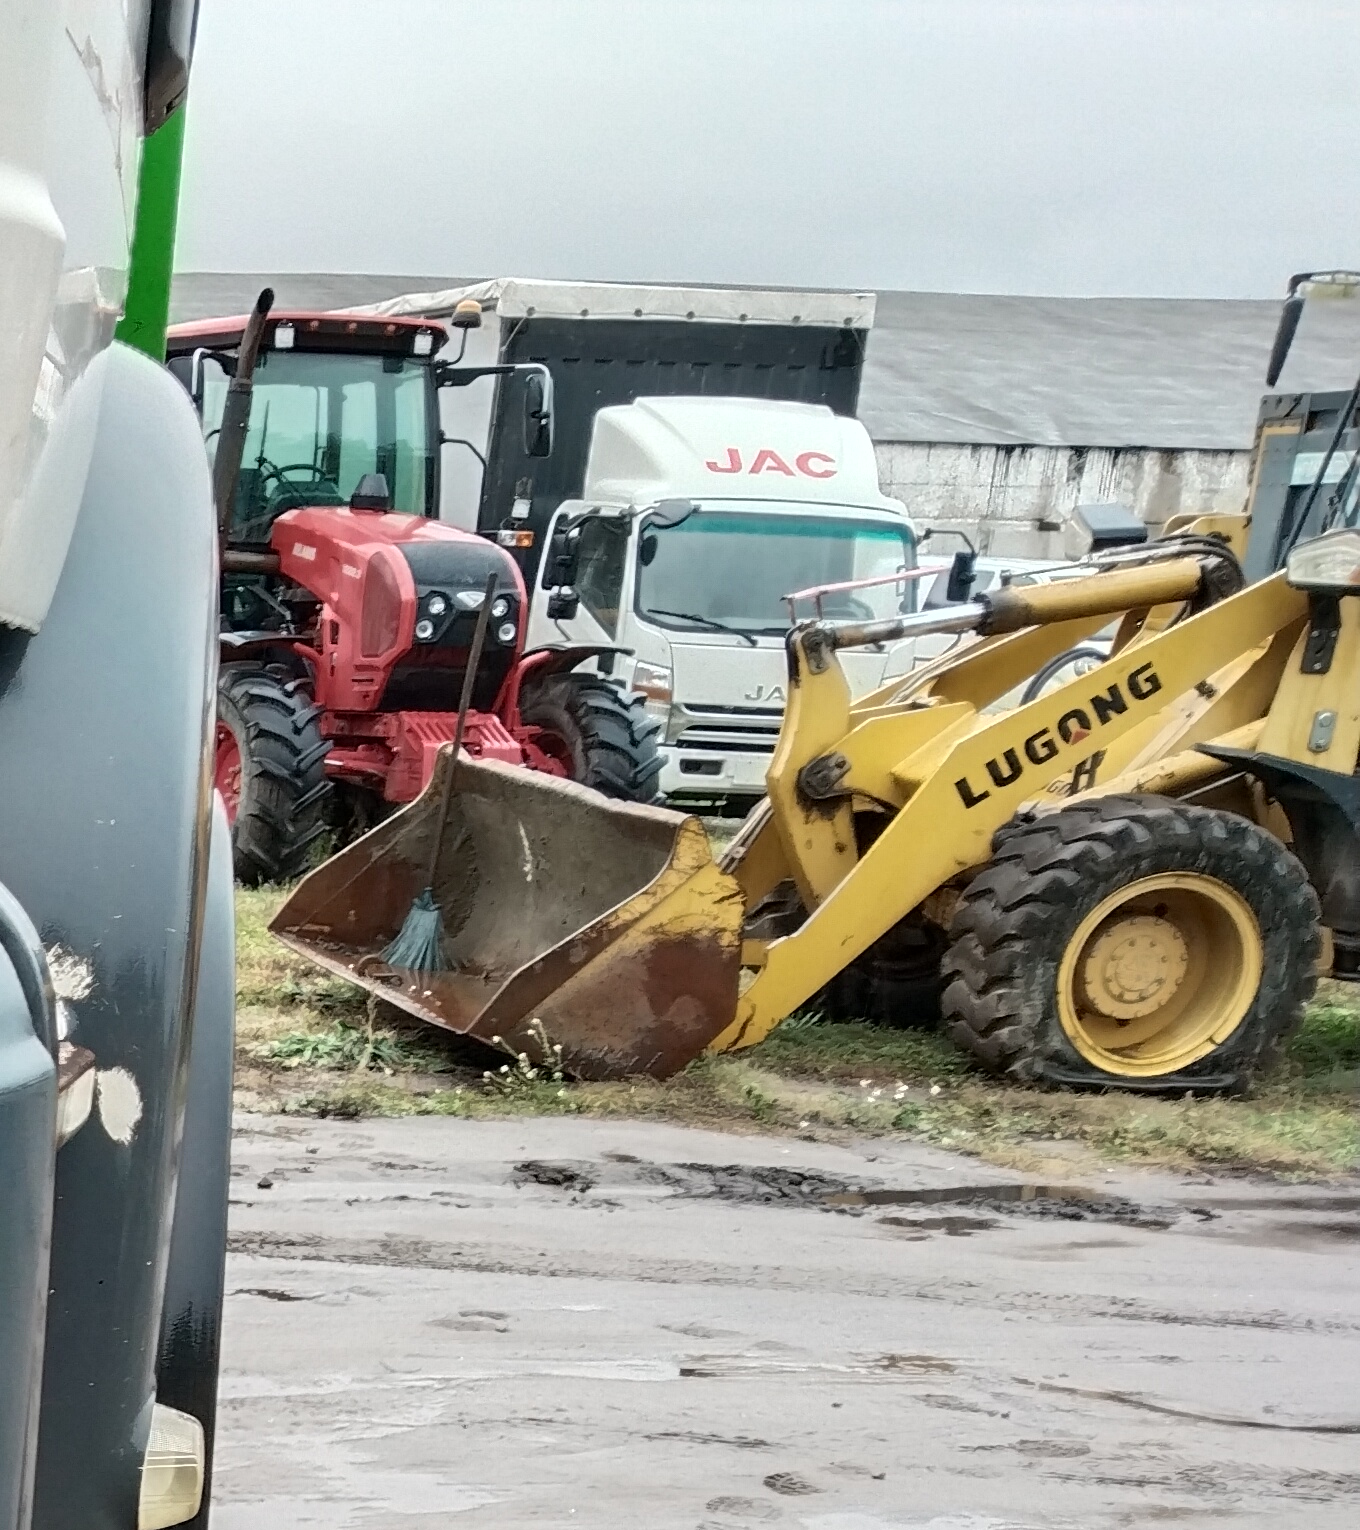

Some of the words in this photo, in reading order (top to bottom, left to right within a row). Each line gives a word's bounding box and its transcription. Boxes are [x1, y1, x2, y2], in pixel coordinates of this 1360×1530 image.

[705, 447, 838, 478] JAC
[744, 685, 786, 702] JA
[954, 661, 1162, 809] LUGONG
